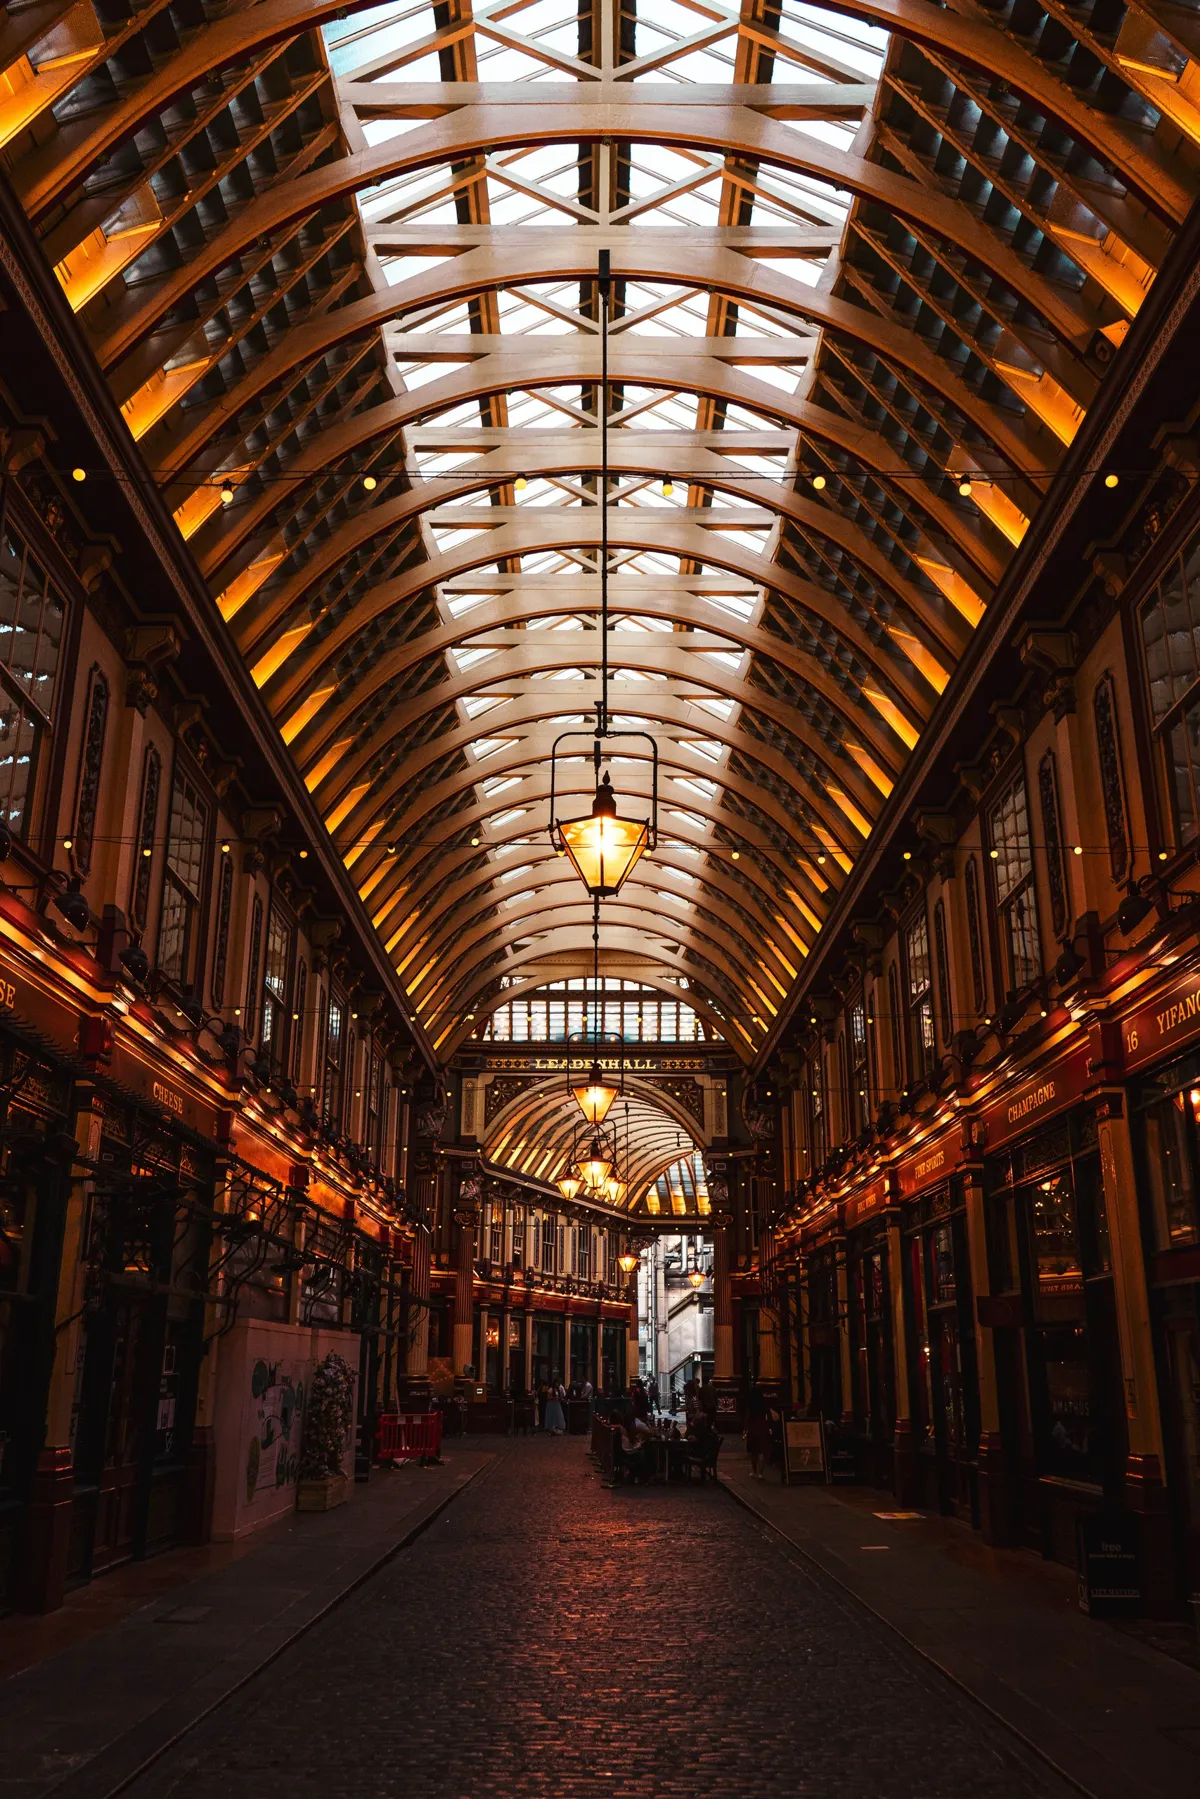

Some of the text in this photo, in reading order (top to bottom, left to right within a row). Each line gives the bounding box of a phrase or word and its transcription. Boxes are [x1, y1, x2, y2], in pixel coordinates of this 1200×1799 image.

[1126, 1030, 1139, 1054] 16
[535, 1058, 657, 1070] LEADENHALL
[153, 1081, 184, 1115] CHEESE
[1007, 1081, 1056, 1124] CHAMPAGNE
[1101, 1540, 1122, 1552] free
